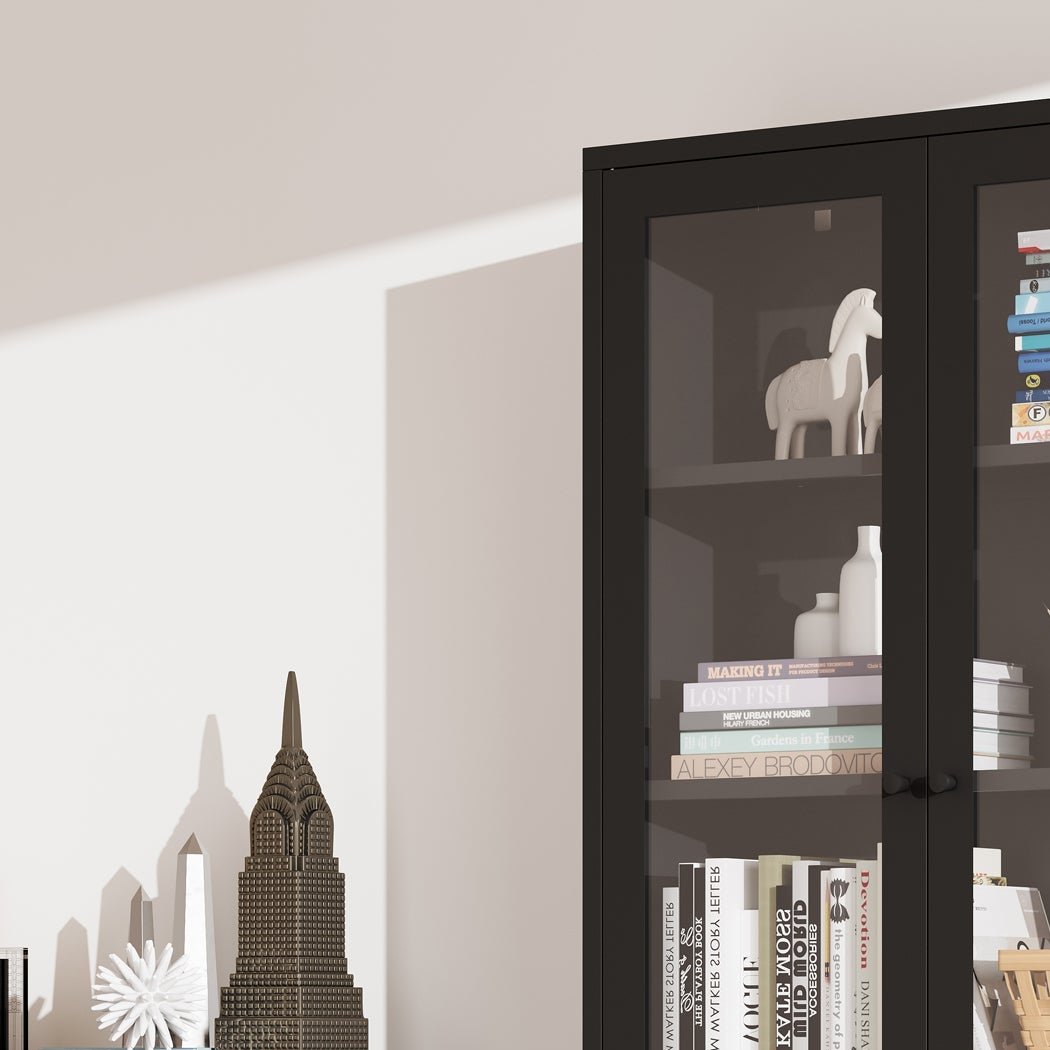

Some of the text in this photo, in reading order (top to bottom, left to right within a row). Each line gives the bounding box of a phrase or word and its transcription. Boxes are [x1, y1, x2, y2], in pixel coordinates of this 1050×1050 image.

[1018, 319, 1037, 327] Toossi
[707, 663, 783, 679] MAKING IT
[689, 684, 790, 707] LOST FISH
[722, 709, 811, 721] NEW URBAN HOUSING
[723, 719, 770, 728] HILARY FRENCH
[751, 732, 855, 747] Gardens in France
[677, 756, 758, 779] ALEXEY
[861, 871, 870, 969] Devotion
[834, 929, 843, 950] the
[832, 954, 842, 1019] geometry
[861, 981, 870, 1016] DANI
[834, 1023, 843, 1038] of
